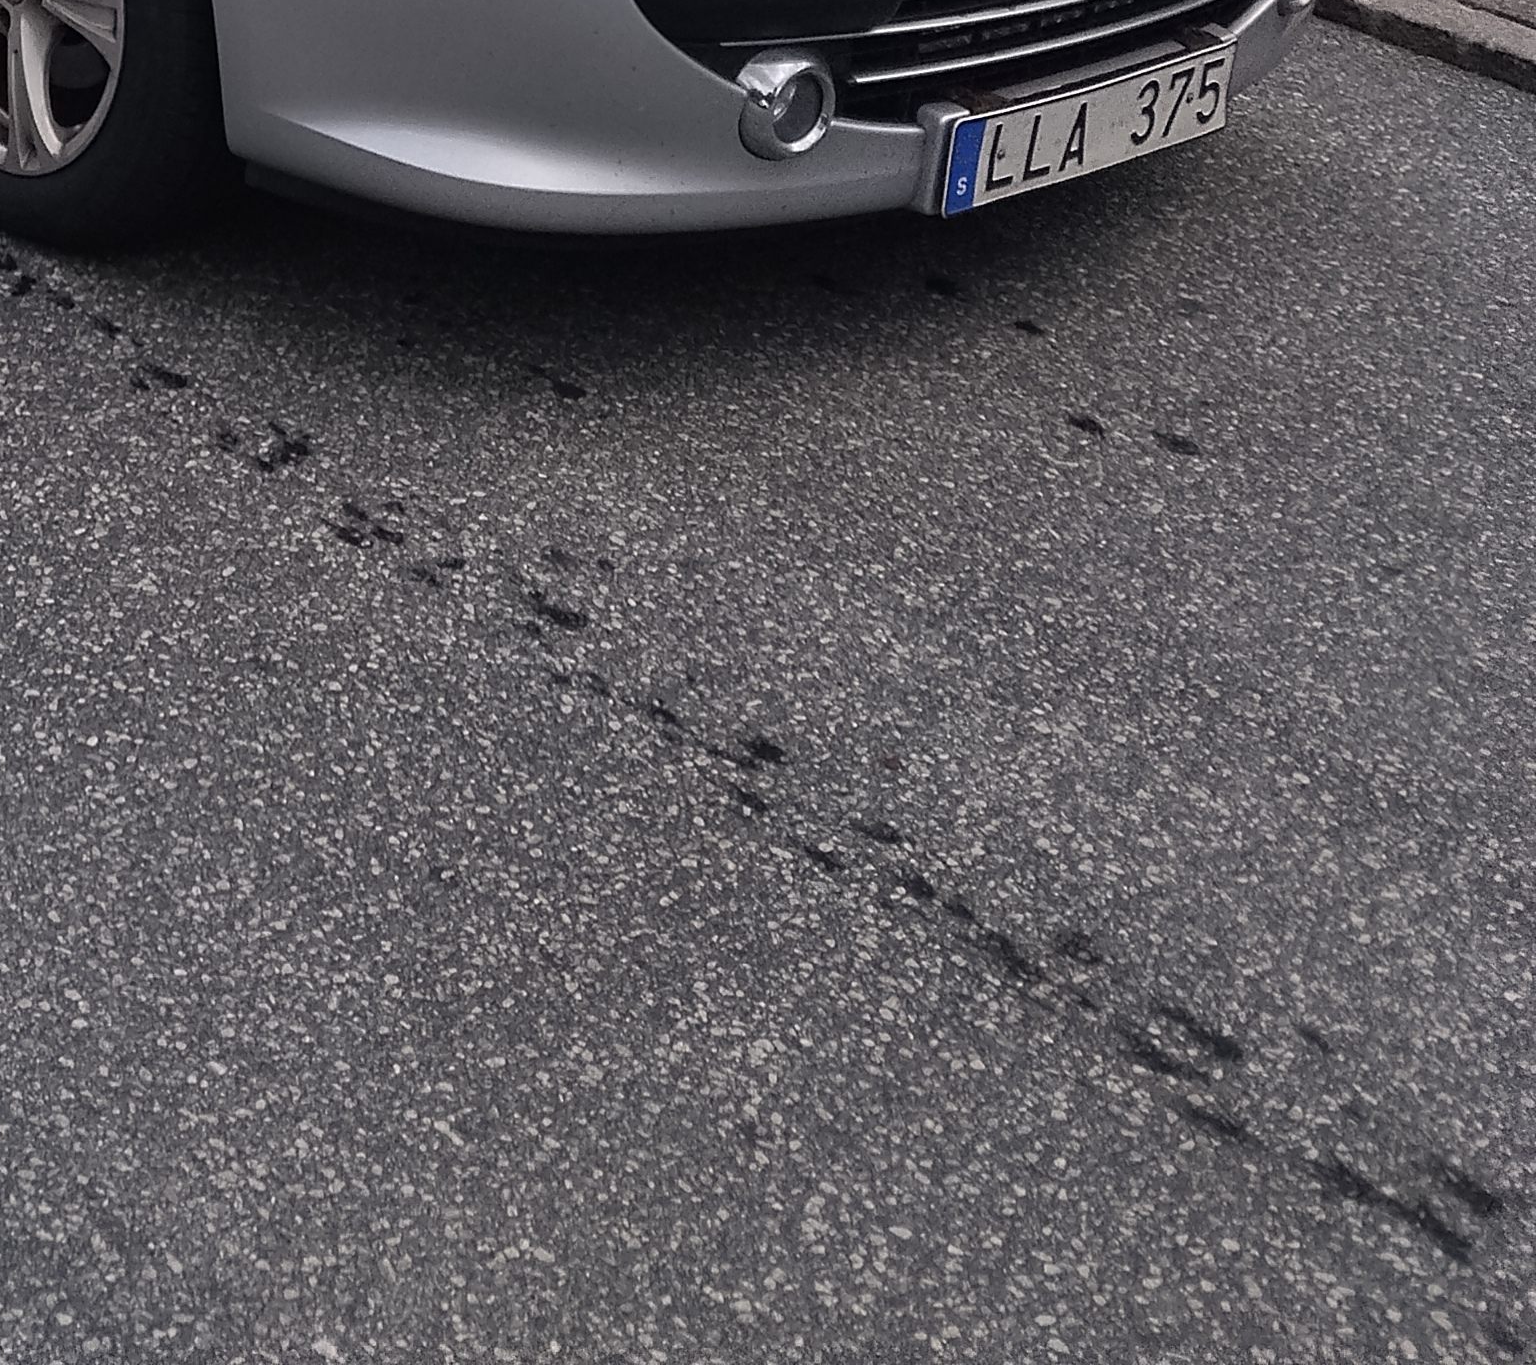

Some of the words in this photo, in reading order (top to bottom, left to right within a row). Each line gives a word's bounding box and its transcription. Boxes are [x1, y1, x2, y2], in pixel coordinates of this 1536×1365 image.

[985, 102, 1088, 191] LLA
[1130, 58, 1226, 145] 375
[955, 176, 968, 197] S
